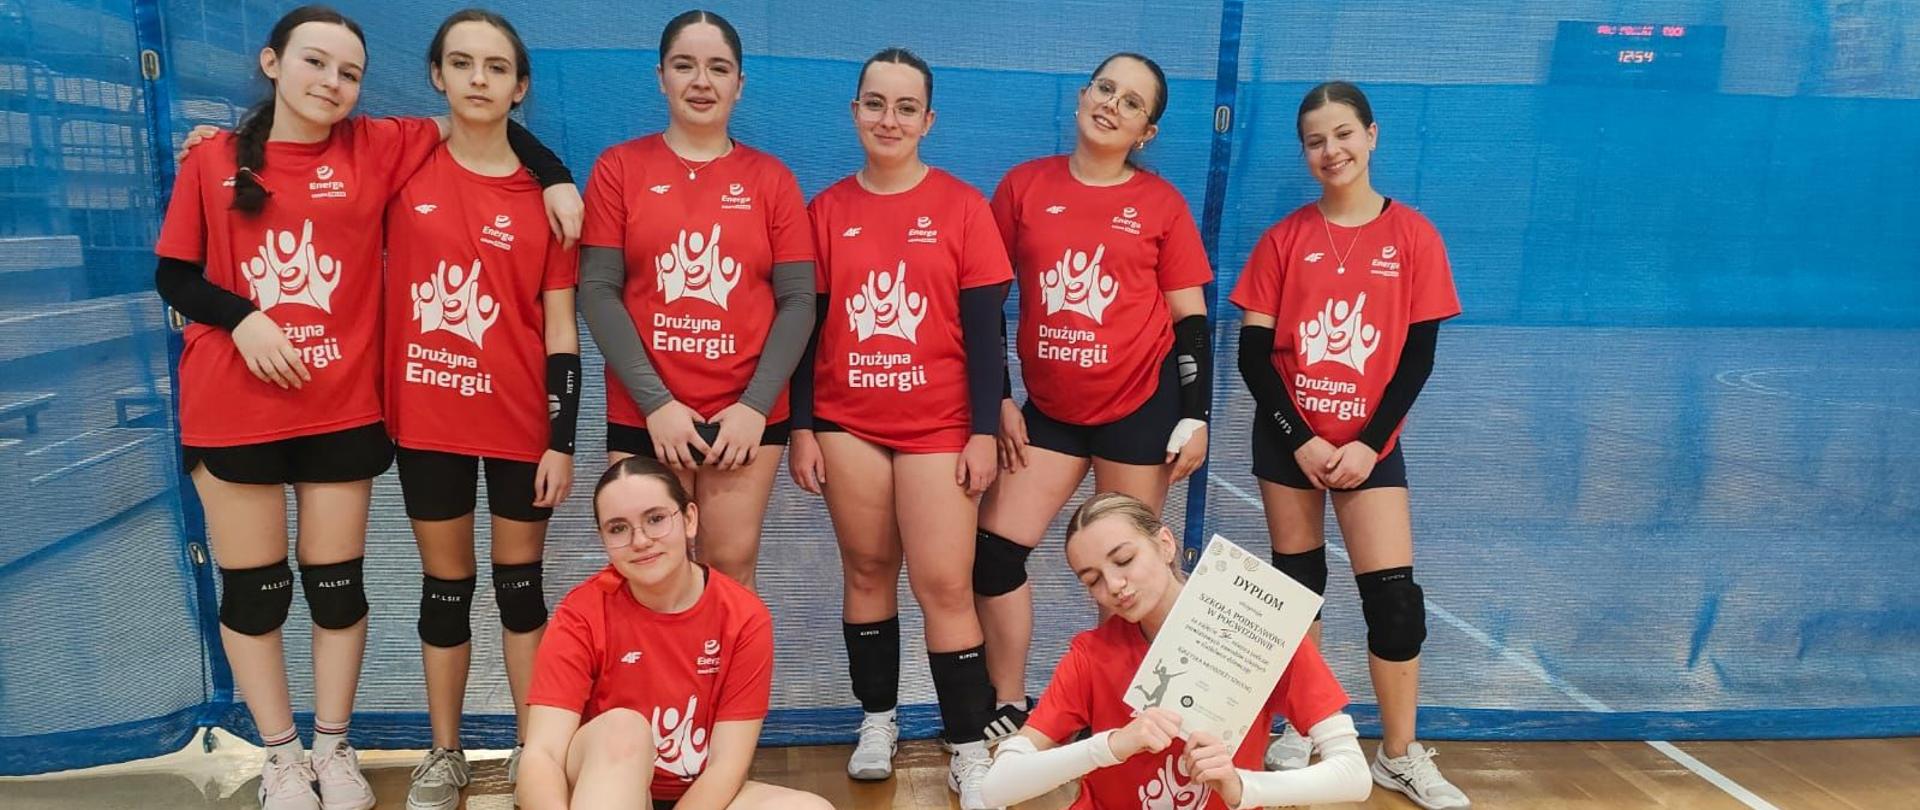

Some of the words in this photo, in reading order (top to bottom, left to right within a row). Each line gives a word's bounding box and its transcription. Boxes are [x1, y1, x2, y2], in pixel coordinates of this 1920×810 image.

[309, 181, 344, 190] Energa
[650, 184, 672, 195] 4F
[721, 194, 752, 203] Energa
[414, 203, 437, 215] 4F
[1046, 205, 1066, 214] 4F
[1111, 216, 1141, 229] Energa
[481, 225, 514, 242] Energa
[843, 227, 863, 237] 4F
[908, 228, 938, 237] Energa
[1304, 252, 1325, 264] 4F
[653, 313, 721, 333] Drużyna
[283, 322, 326, 343] żyna
[1038, 325, 1096, 342] Drużyna
[652, 330, 736, 360] Energii
[406, 343, 479, 369] Drużyna
[849, 352, 911, 370] Drużyna
[1037, 341, 1109, 368] Energii
[405, 362, 493, 396] Energii
[848, 366, 926, 392] Energii
[1295, 374, 1357, 396] Drużyna
[1296, 391, 1366, 421] Energii
[318, 579, 351, 588] ALLSIX
[1232, 575, 1285, 612] DYPLOM
[1198, 593, 1232, 617] SZKOŁA
[1207, 607, 1217, 616] W
[621, 650, 642, 664] 4F
